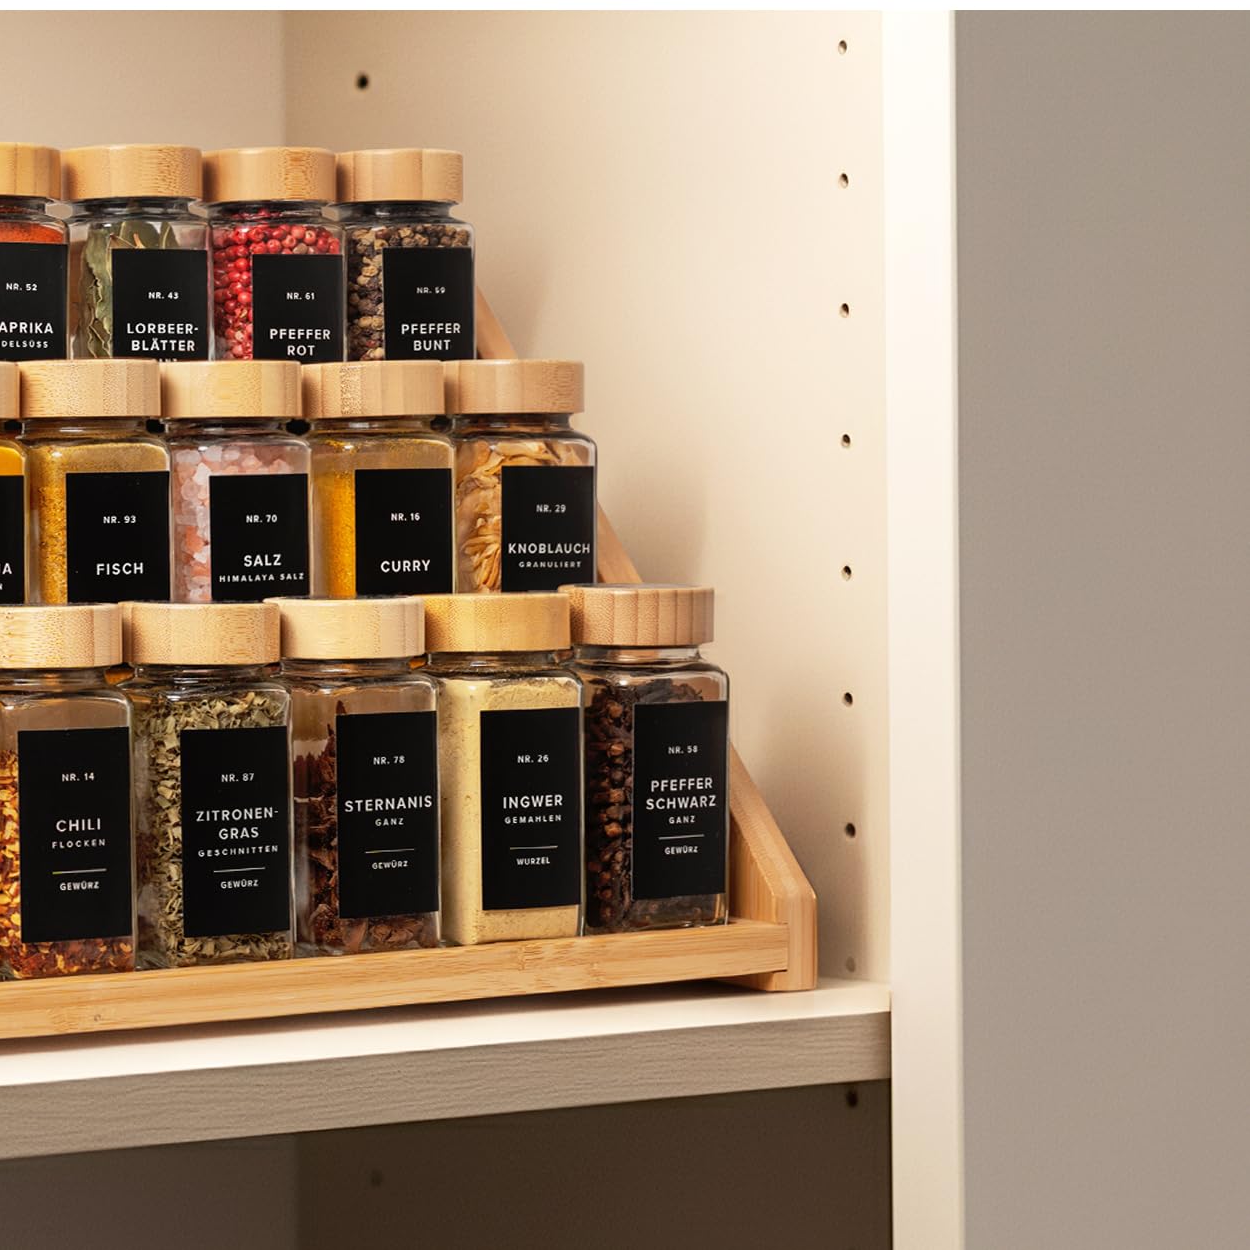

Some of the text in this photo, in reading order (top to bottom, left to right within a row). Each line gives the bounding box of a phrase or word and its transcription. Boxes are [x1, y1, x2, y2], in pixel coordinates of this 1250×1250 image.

[5, 282, 38, 292] NR. 52
[416, 286, 432, 294] NR.
[148, 291, 179, 300] NR. 43
[286, 292, 315, 301] NR. 61
[126, 322, 199, 335] LORBEER-
[269, 328, 331, 340] PFEFFER
[401, 322, 461, 335] PFEFFER
[132, 338, 194, 351] BLÄTTER
[413, 339, 451, 352] BUNT
[287, 344, 316, 357] ROT
[536, 503, 567, 514] NR. 29
[103, 514, 137, 524] NR. 93
[245, 513, 278, 524] NR. 70
[390, 512, 421, 522] NR. 16
[508, 542, 591, 554] KNOBLAUCH
[244, 554, 281, 567] SALZ
[381, 560, 430, 572] CURRY
[518, 560, 582, 569] GRANULIERT
[97, 563, 143, 575] FISCH
[219, 572, 304, 583] HIMALAYA SALZ
[667, 744, 698, 755] NR. 58
[373, 755, 406, 765] NR. 78
[517, 754, 549, 764] NR. 26
[61, 772, 95, 782] NR. 14
[221, 772, 255, 783] NR. 87
[651, 777, 712, 792] PFEFFER
[345, 796, 432, 812] STERNANIS
[504, 795, 562, 808] INGWER
[646, 795, 716, 810] SCHWARZ
[196, 807, 278, 821] ZITRONEN-
[504, 814, 562, 825] GEMAHLEN
[56, 818, 100, 832] CHILI
[374, 817, 404, 827] GANZ
[668, 815, 696, 825] GANZ
[219, 827, 258, 839] GRAS
[51, 838, 106, 849] FLOCKEN
[198, 845, 277, 857] GESCHNITTEN
[664, 845, 698, 855] GEWÜRZ
[371, 859, 409, 870] GEWÜRZ
[516, 856, 551, 866] WURZEL
[59, 880, 100, 891] GEWÜRZ
[220, 878, 259, 890] GEWÜRZ
